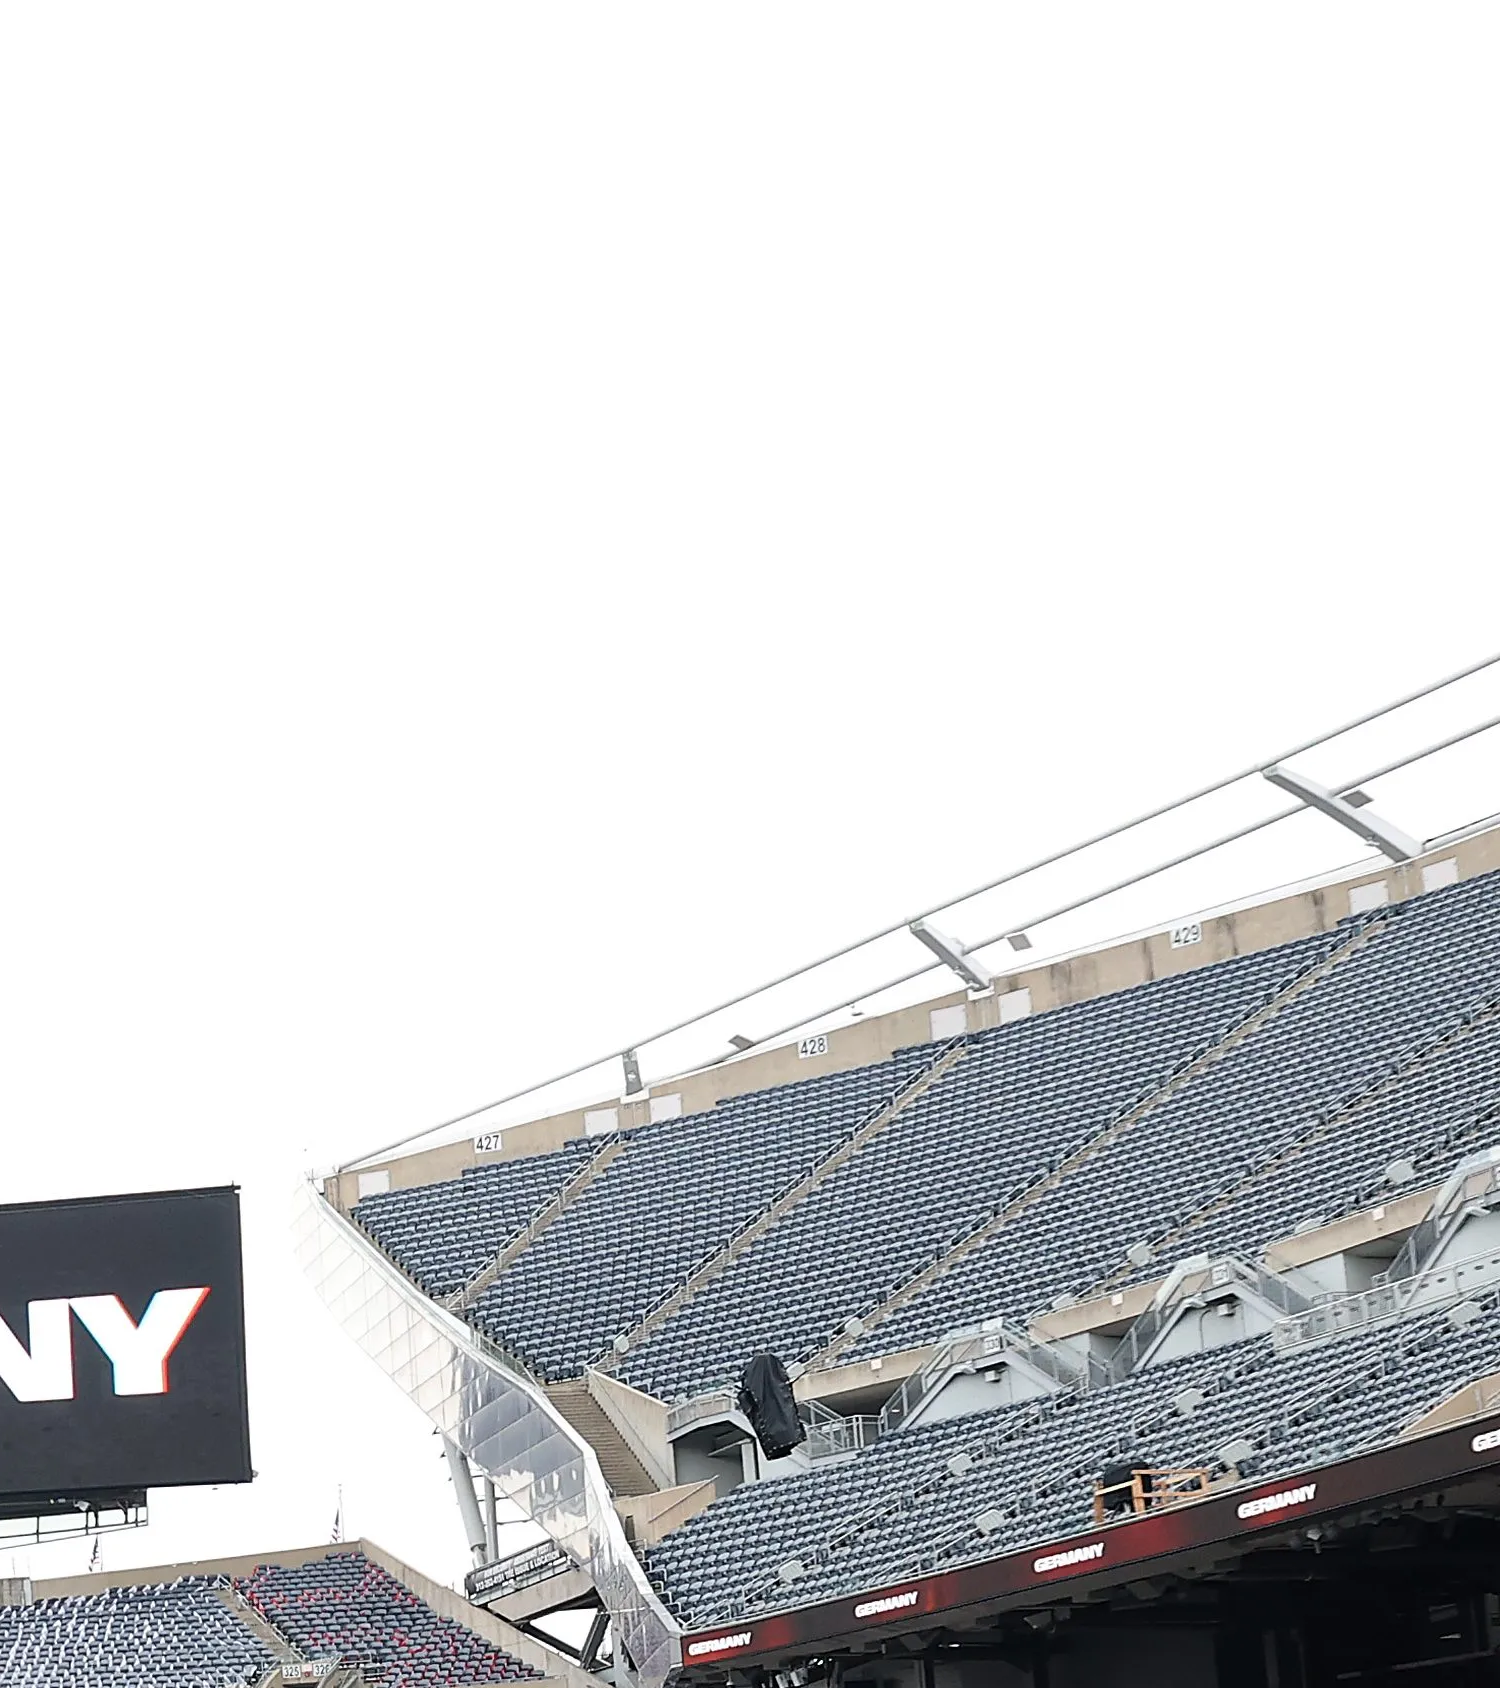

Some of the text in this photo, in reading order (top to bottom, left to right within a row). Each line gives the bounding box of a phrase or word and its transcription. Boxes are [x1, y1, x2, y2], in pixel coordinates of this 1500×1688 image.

[1237, 1484, 1316, 1518] GERMANY
[1034, 1543, 1104, 1573] GERMANY
[855, 1591, 918, 1618] GERMANY
[688, 1631, 752, 1656] GERMANY
[285, 1666, 301, 1678] 325
